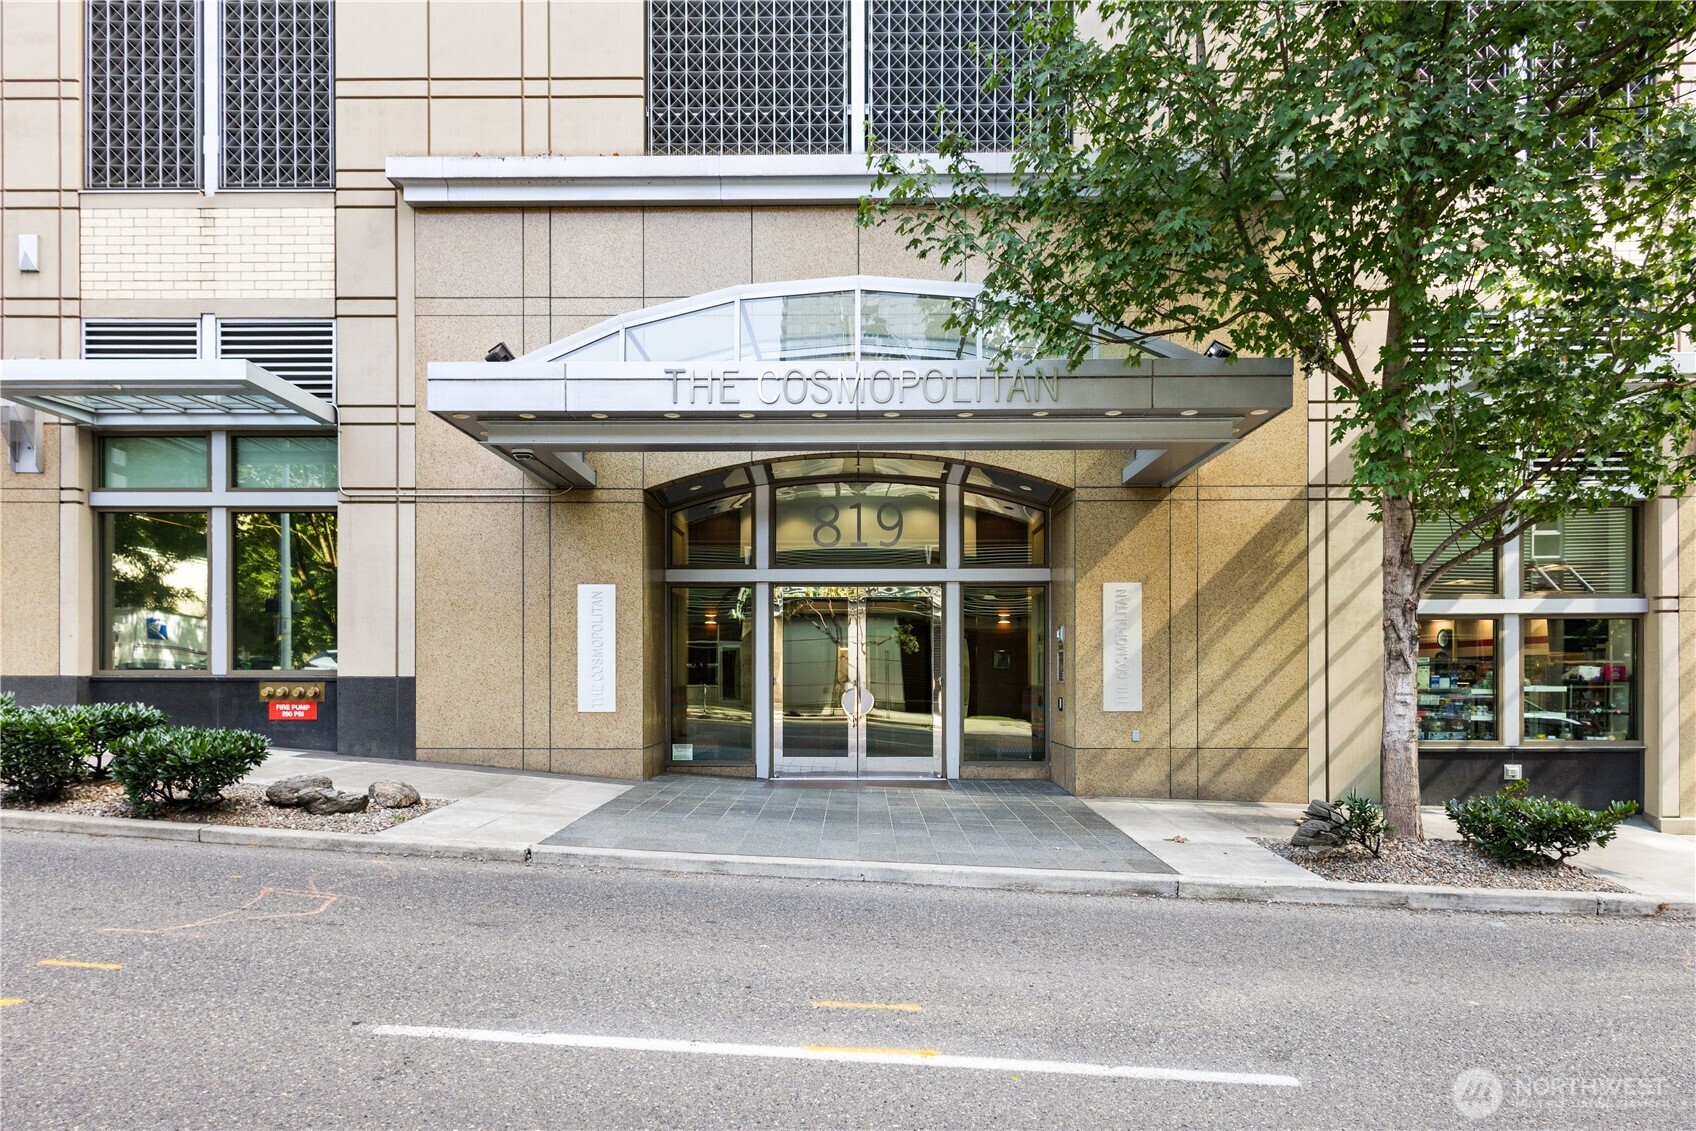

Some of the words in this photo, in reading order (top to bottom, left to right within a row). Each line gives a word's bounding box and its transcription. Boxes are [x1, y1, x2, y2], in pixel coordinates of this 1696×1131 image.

[664, 368, 739, 404] THE
[757, 366, 1059, 403] COSMOPOLITAN
[813, 502, 904, 548] 819
[591, 590, 604, 681] COSMOPOLITAN
[1116, 589, 1129, 680] COSMOPOLITAN
[293, 710, 305, 718] PSI
[591, 684, 604, 709] THE
